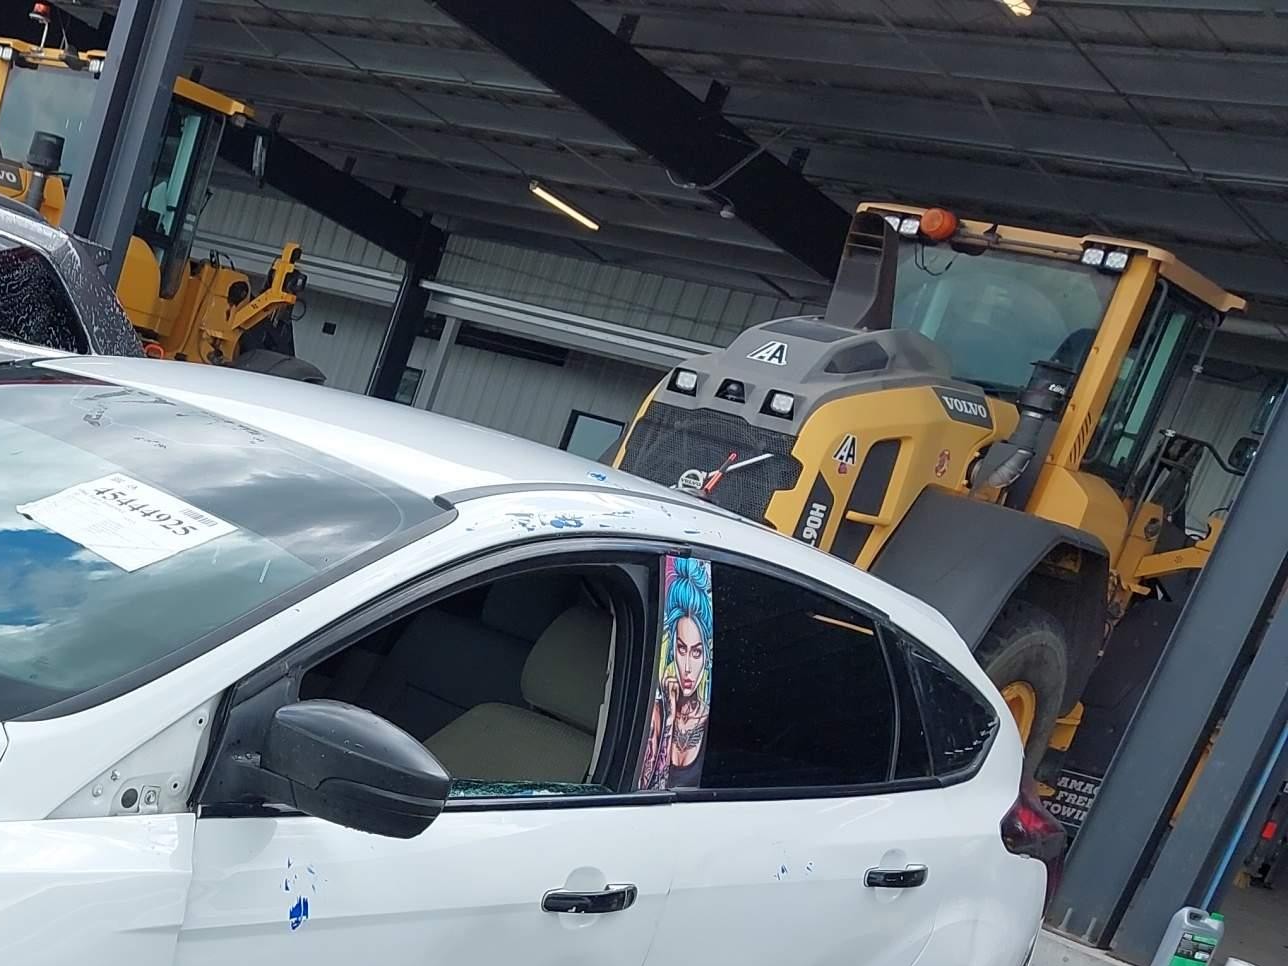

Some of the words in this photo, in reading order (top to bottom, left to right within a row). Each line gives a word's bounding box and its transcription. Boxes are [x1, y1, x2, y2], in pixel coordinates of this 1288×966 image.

[941, 395, 988, 418] VOLVO
[93, 487, 198, 536] 45444925
[802, 502, 828, 547] 90H
